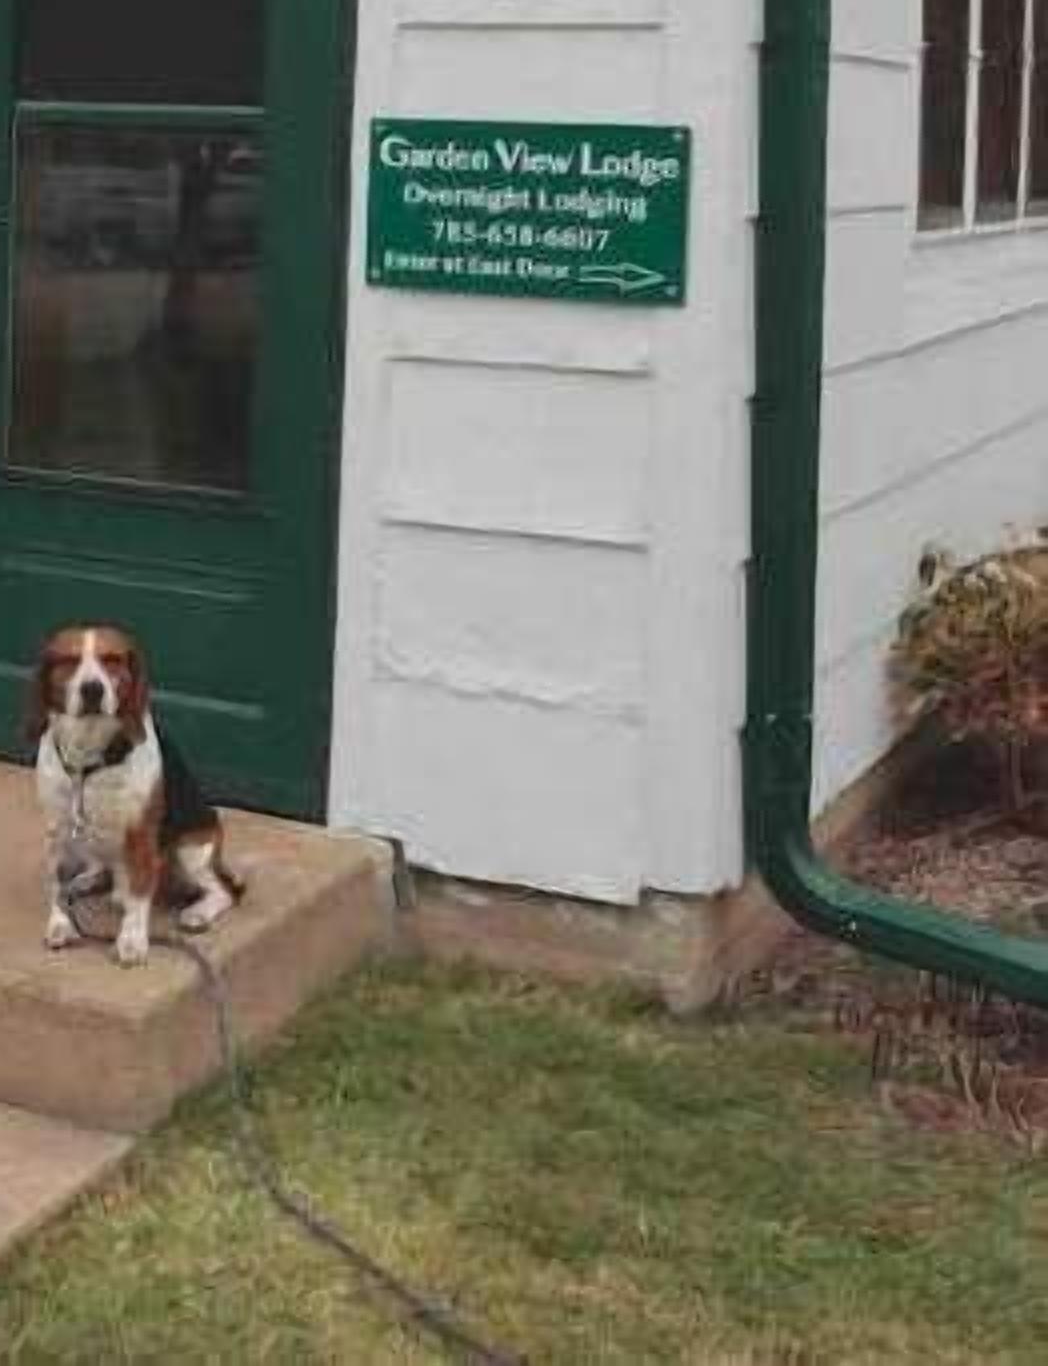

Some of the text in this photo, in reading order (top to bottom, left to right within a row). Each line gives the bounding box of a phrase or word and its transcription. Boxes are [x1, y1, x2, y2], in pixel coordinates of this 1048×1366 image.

[380, 136, 680, 187] Garden View Lodge
[404, 182, 647, 224] Overnight Lodging
